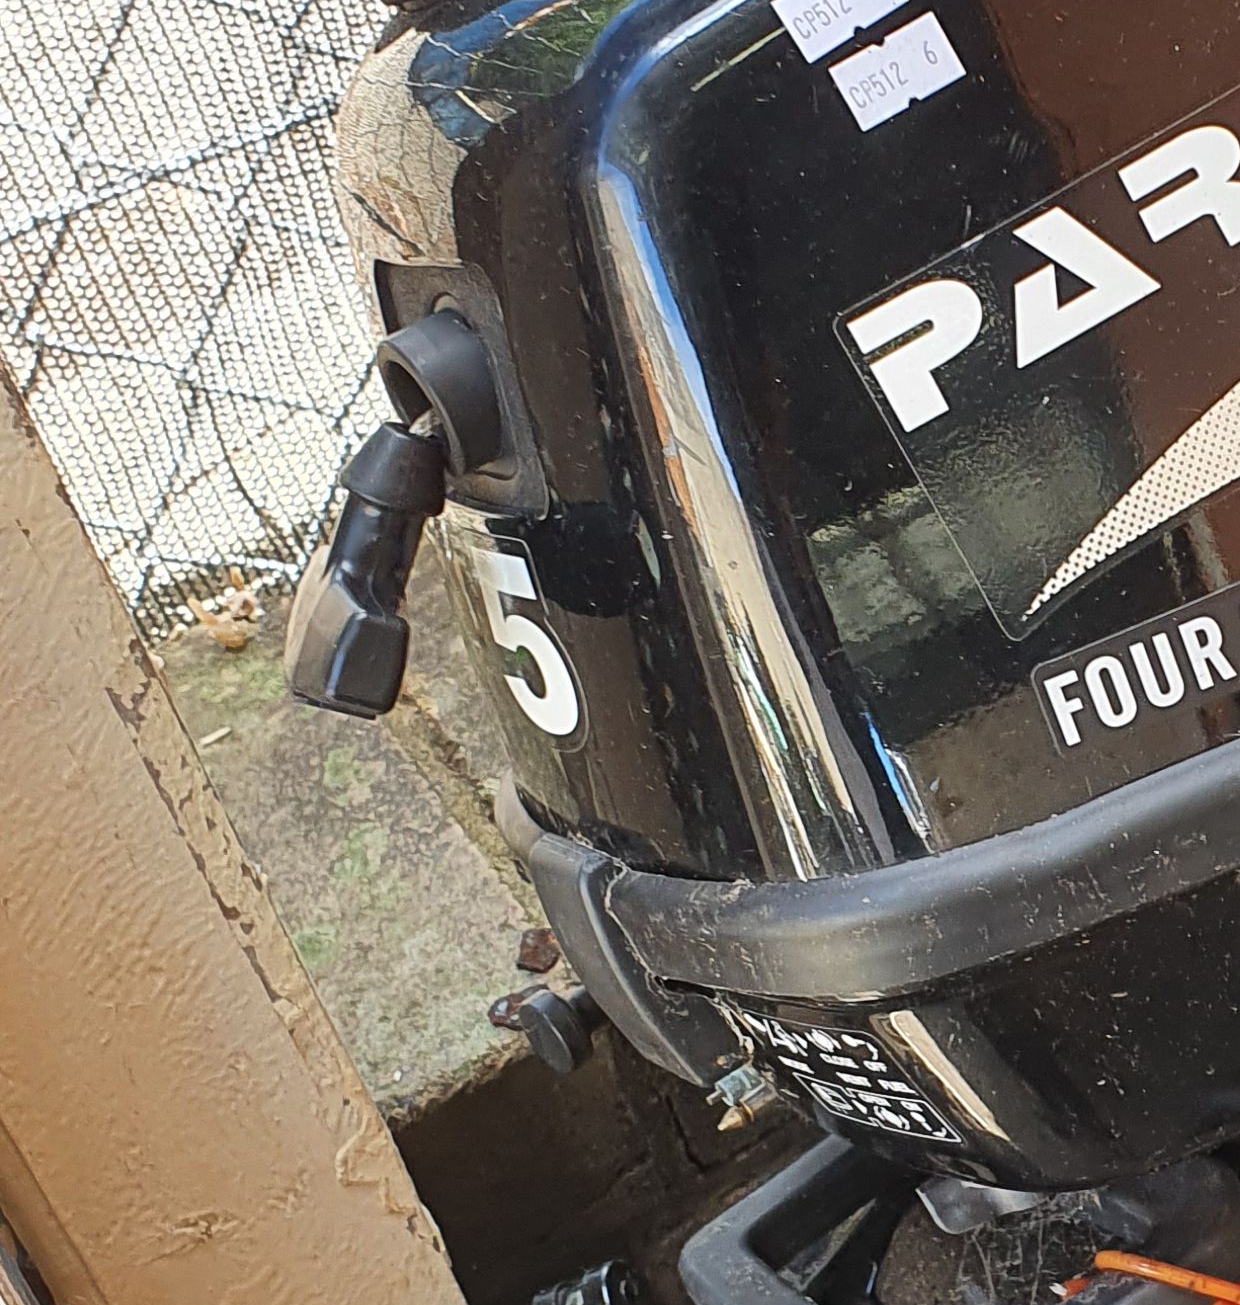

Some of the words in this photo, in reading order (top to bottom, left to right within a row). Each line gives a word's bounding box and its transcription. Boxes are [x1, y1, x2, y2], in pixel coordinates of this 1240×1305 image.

[848, 60, 910, 111] CP512
[923, 40, 938, 66] 6
[473, 549, 580, 736] 5
[1042, 614, 1237, 747] FOUR
